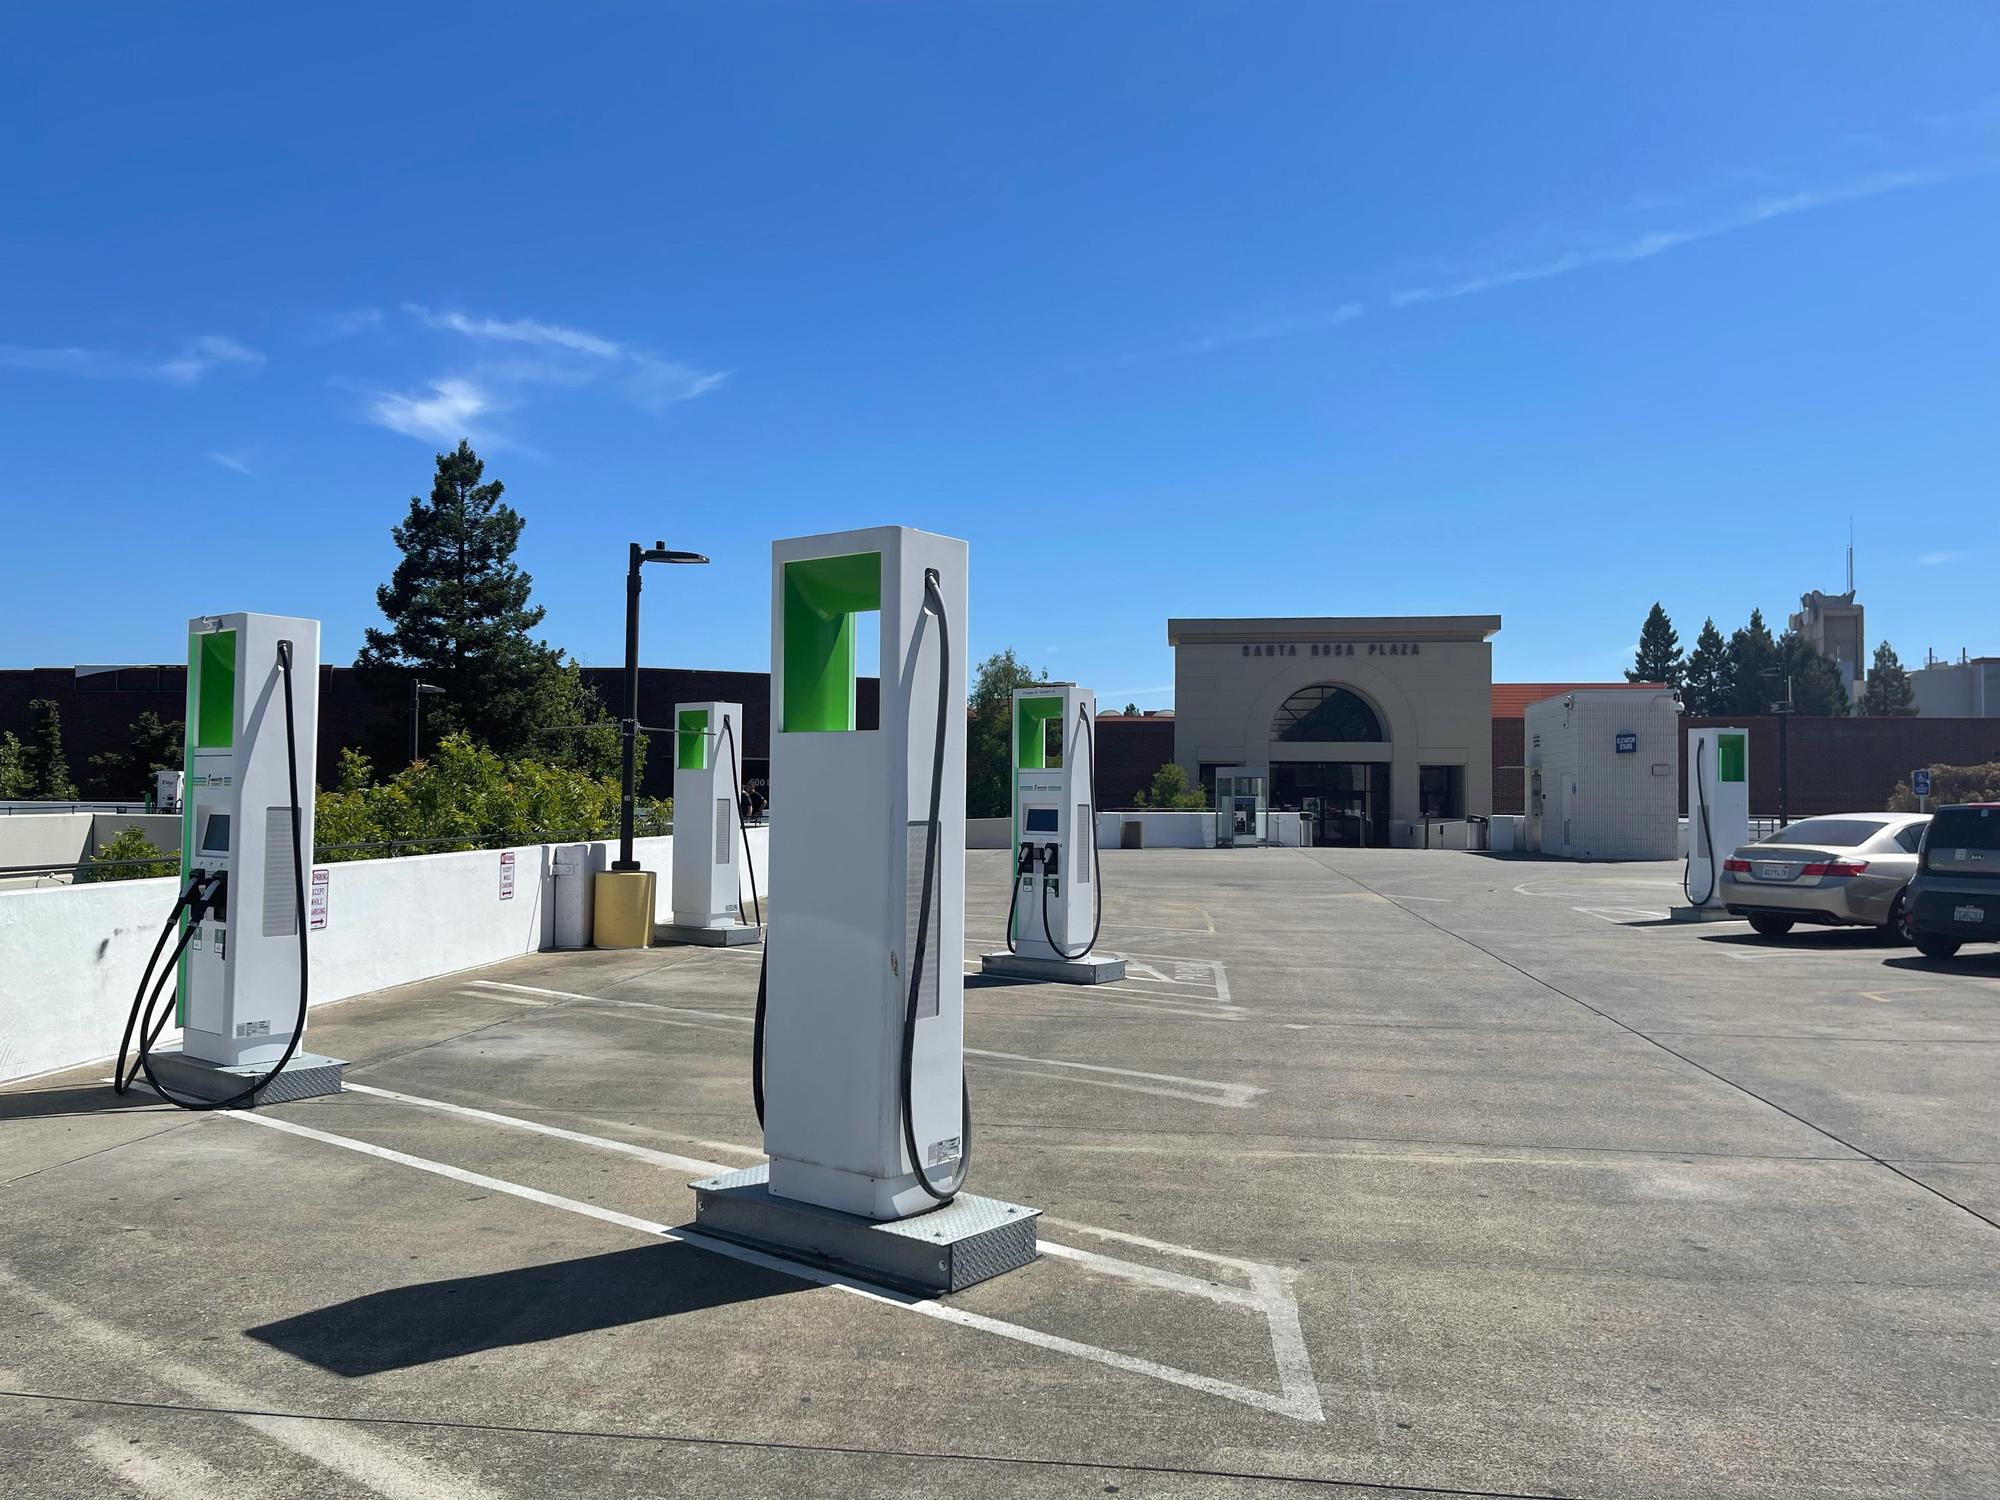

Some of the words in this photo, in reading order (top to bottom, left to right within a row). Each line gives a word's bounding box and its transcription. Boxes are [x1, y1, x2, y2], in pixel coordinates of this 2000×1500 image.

[1242, 644, 1297, 657] SANTA
[1311, 644, 1355, 657] ROSA
[1368, 643, 1421, 656] PLAZA
